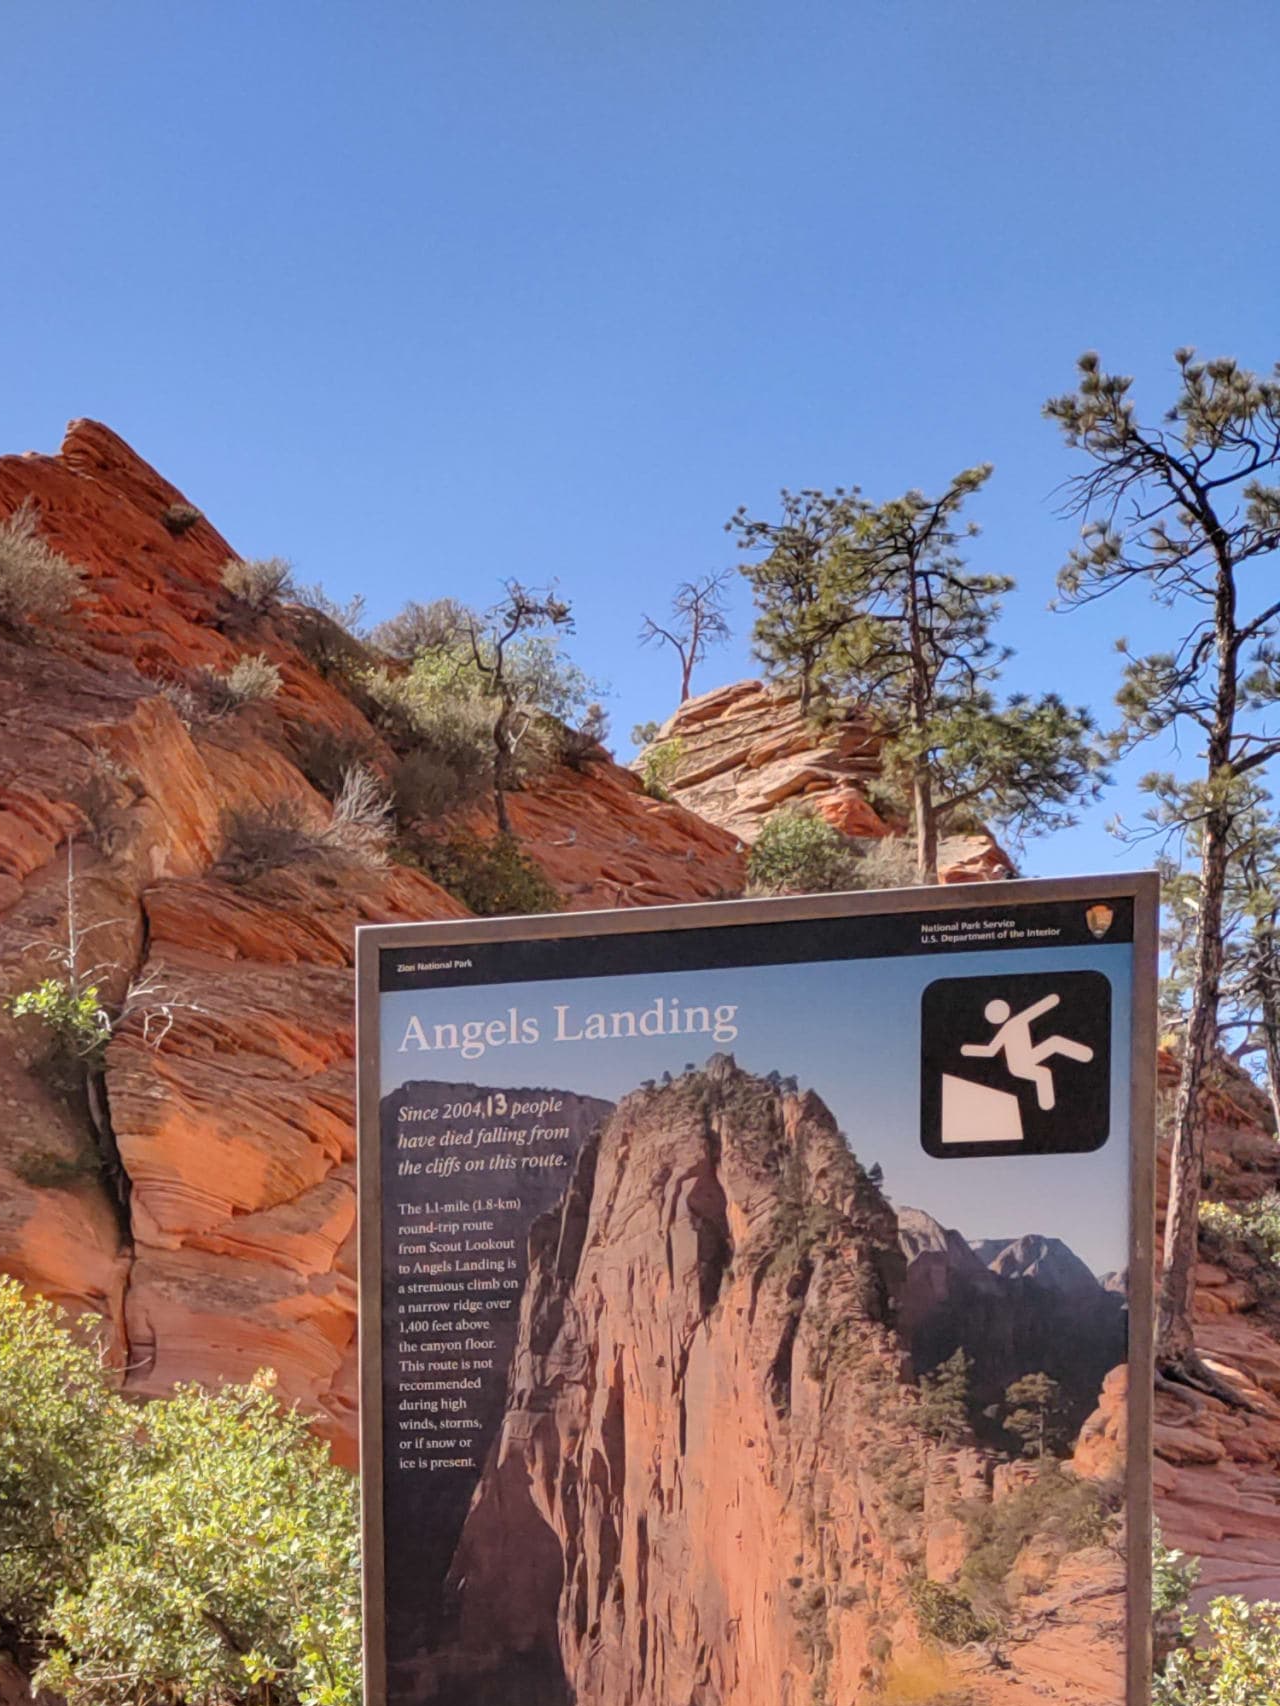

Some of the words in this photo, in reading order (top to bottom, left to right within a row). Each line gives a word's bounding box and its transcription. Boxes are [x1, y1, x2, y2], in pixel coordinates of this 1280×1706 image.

[921, 923, 958, 932] National
[961, 922, 981, 930] Park
[983, 920, 1015, 928] Service
[921, 936, 938, 944] U.S.
[941, 932, 995, 943] Department
[998, 930, 1008, 938] of
[1010, 930, 1024, 938] the
[1027, 928, 1060, 936] Interior
[397, 964, 415, 972] Zion
[417, 961, 452, 970] National
[454, 959, 472, 968] Park
[398, 1007, 540, 1059] Angels
[553, 997, 738, 1042] Landing
[398, 1106, 439, 1122] Since
[442, 1103, 485, 1119] 2004,
[486, 1093, 507, 1117] 13
[511, 1097, 563, 1117] people
[398, 1134, 435, 1148] have
[440, 1129, 472, 1145] died
[474, 1128, 526, 1148] falling
[527, 1126, 569, 1144] from
[398, 1160, 422, 1176] the
[425, 1156, 461, 1178] cliffs
[465, 1159, 484, 1171] on
[489, 1154, 517, 1169] this
[521, 1152, 568, 1167] route.
[398, 1203, 421, 1215] The
[425, 1201, 469, 1213] 1.1-mile
[472, 1198, 521, 1212] (1.8-km)
[398, 1221, 460, 1235] round-trip
[463, 1220, 494, 1231] route
[398, 1242, 426, 1254] from
[429, 1241, 462, 1253] Scout
[465, 1239, 515, 1251] Lookout
[399, 1264, 410, 1274] to
[413, 1261, 452, 1276] Angels
[455, 1258, 504, 1273] Landing
[507, 1259, 516, 1269] is
[398, 1285, 405, 1294] a
[407, 1282, 464, 1293] strenuous
[467, 1278, 500, 1289] climb
[503, 1280, 518, 1289] on
[398, 1305, 405, 1313] a
[408, 1303, 449, 1313] narrow
[453, 1300, 482, 1313] ridge
[485, 1300, 512, 1310] over
[399, 1321, 429, 1333] 1,400
[432, 1320, 452, 1331] feet
[455, 1319, 490, 1331] above
[399, 1342, 417, 1352] the
[420, 1342, 462, 1353] canyon
[465, 1339, 496, 1349] floor.
[399, 1361, 425, 1371] This
[428, 1361, 458, 1370] route
[462, 1360, 470, 1369] is
[473, 1358, 493, 1368] not
[399, 1377, 482, 1391] recommended
[399, 1400, 438, 1412] during
[441, 1397, 467, 1411] high
[399, 1418, 437, 1430] winds,
[440, 1419, 482, 1428] storms,
[399, 1439, 412, 1449] or
[415, 1438, 424, 1448] if
[426, 1439, 456, 1448] snow
[459, 1438, 472, 1447] or
[400, 1458, 415, 1468] ice
[419, 1458, 427, 1468] is
[430, 1458, 476, 1470] present.
